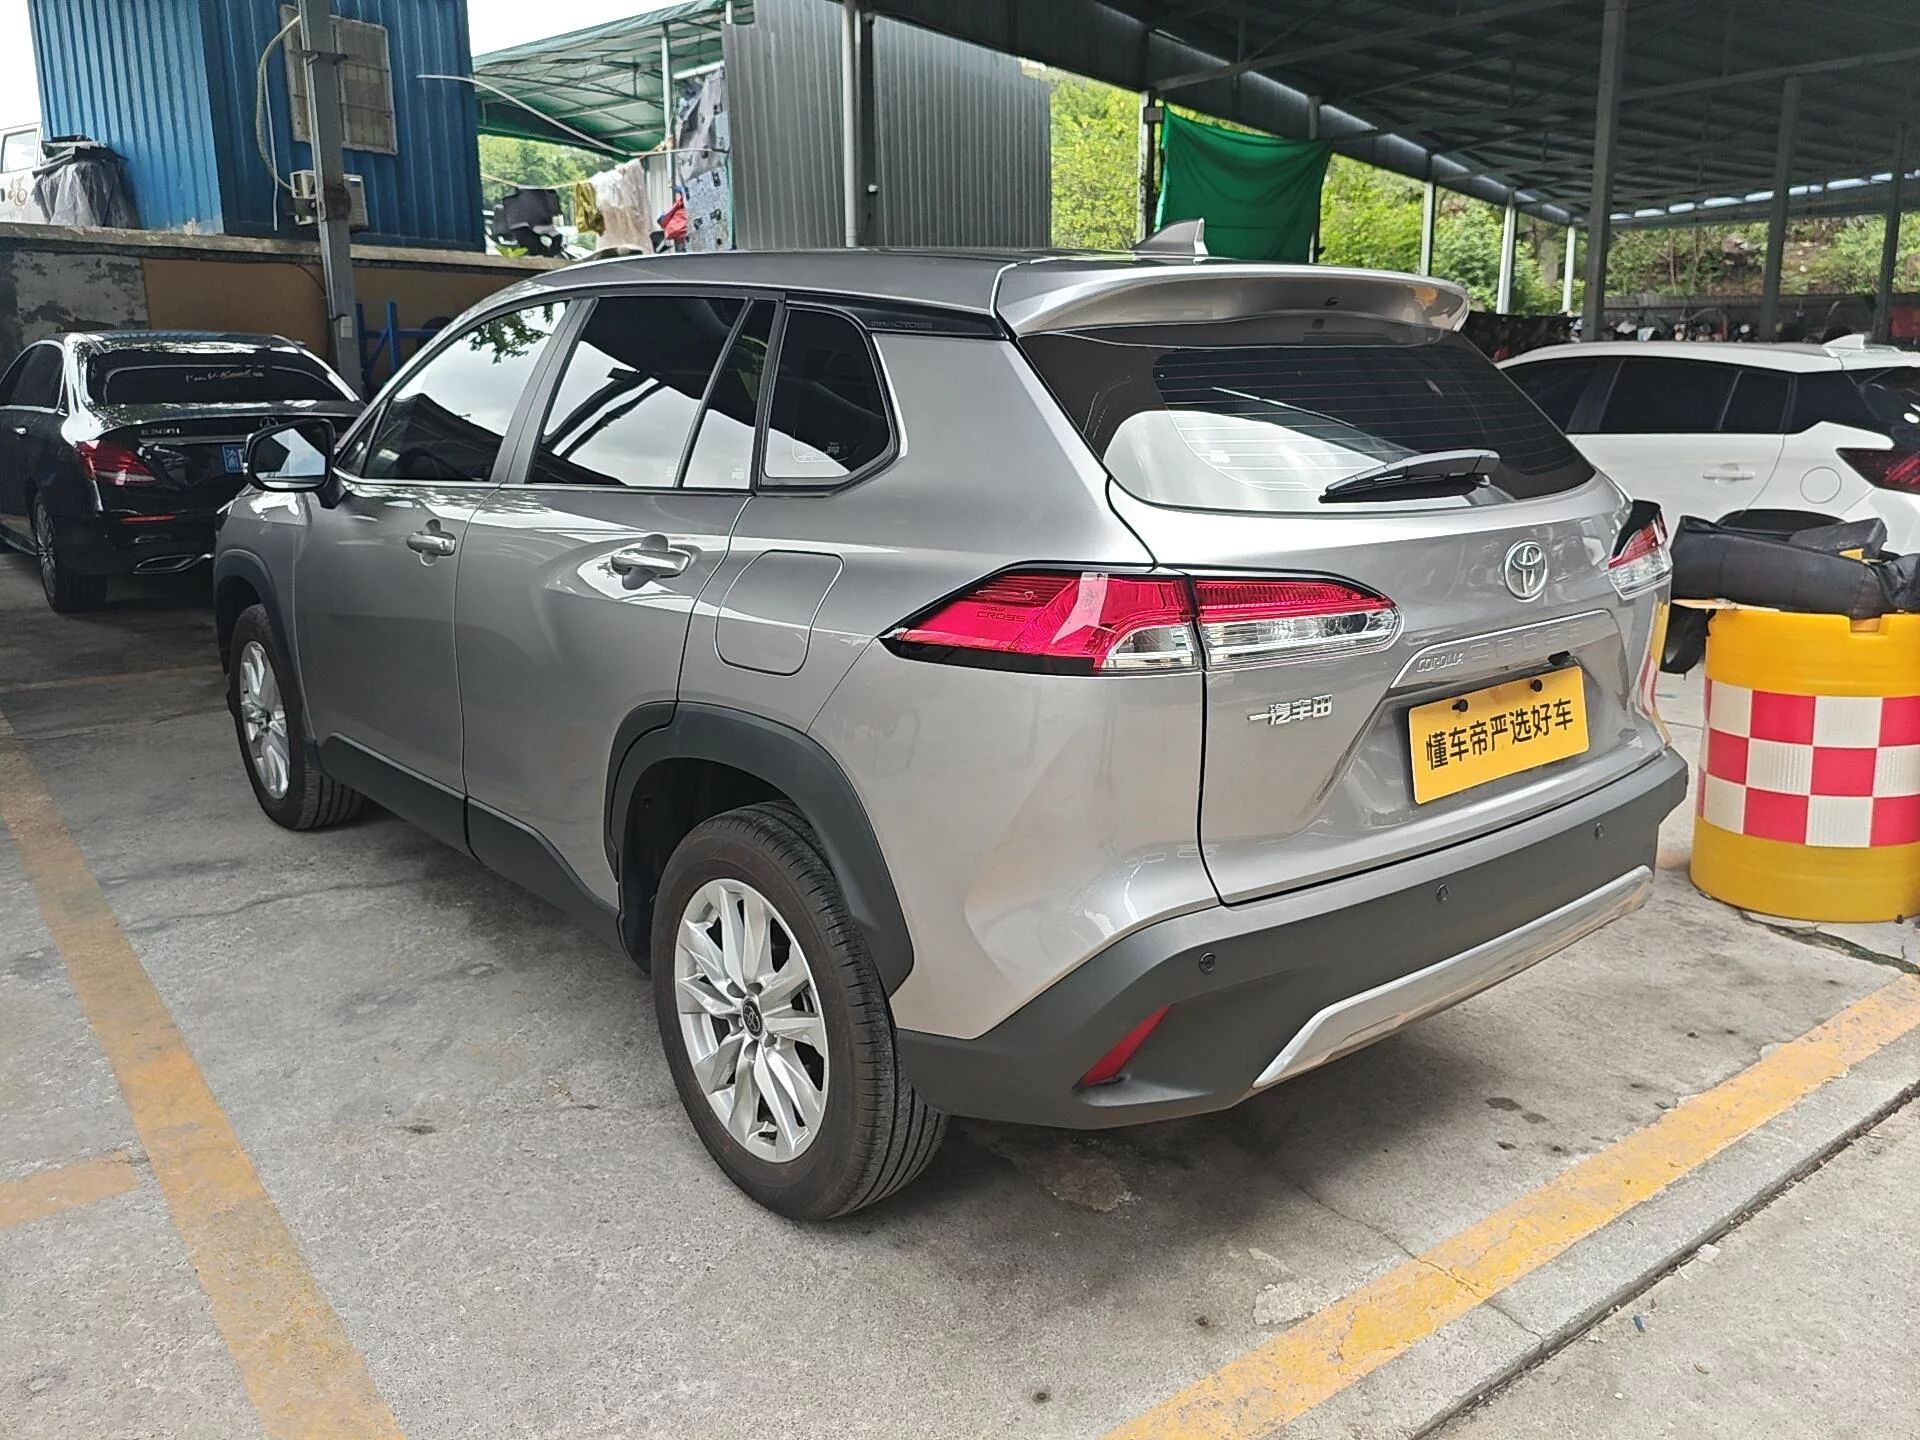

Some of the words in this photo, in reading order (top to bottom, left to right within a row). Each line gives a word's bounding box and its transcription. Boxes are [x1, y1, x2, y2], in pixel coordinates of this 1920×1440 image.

[976, 611, 1027, 622] CROSS
[1417, 652, 1464, 673] COROLLA
[1248, 694, 1333, 725] 一汽丰田
[1426, 698, 1573, 770] 懂车帝严选好车
